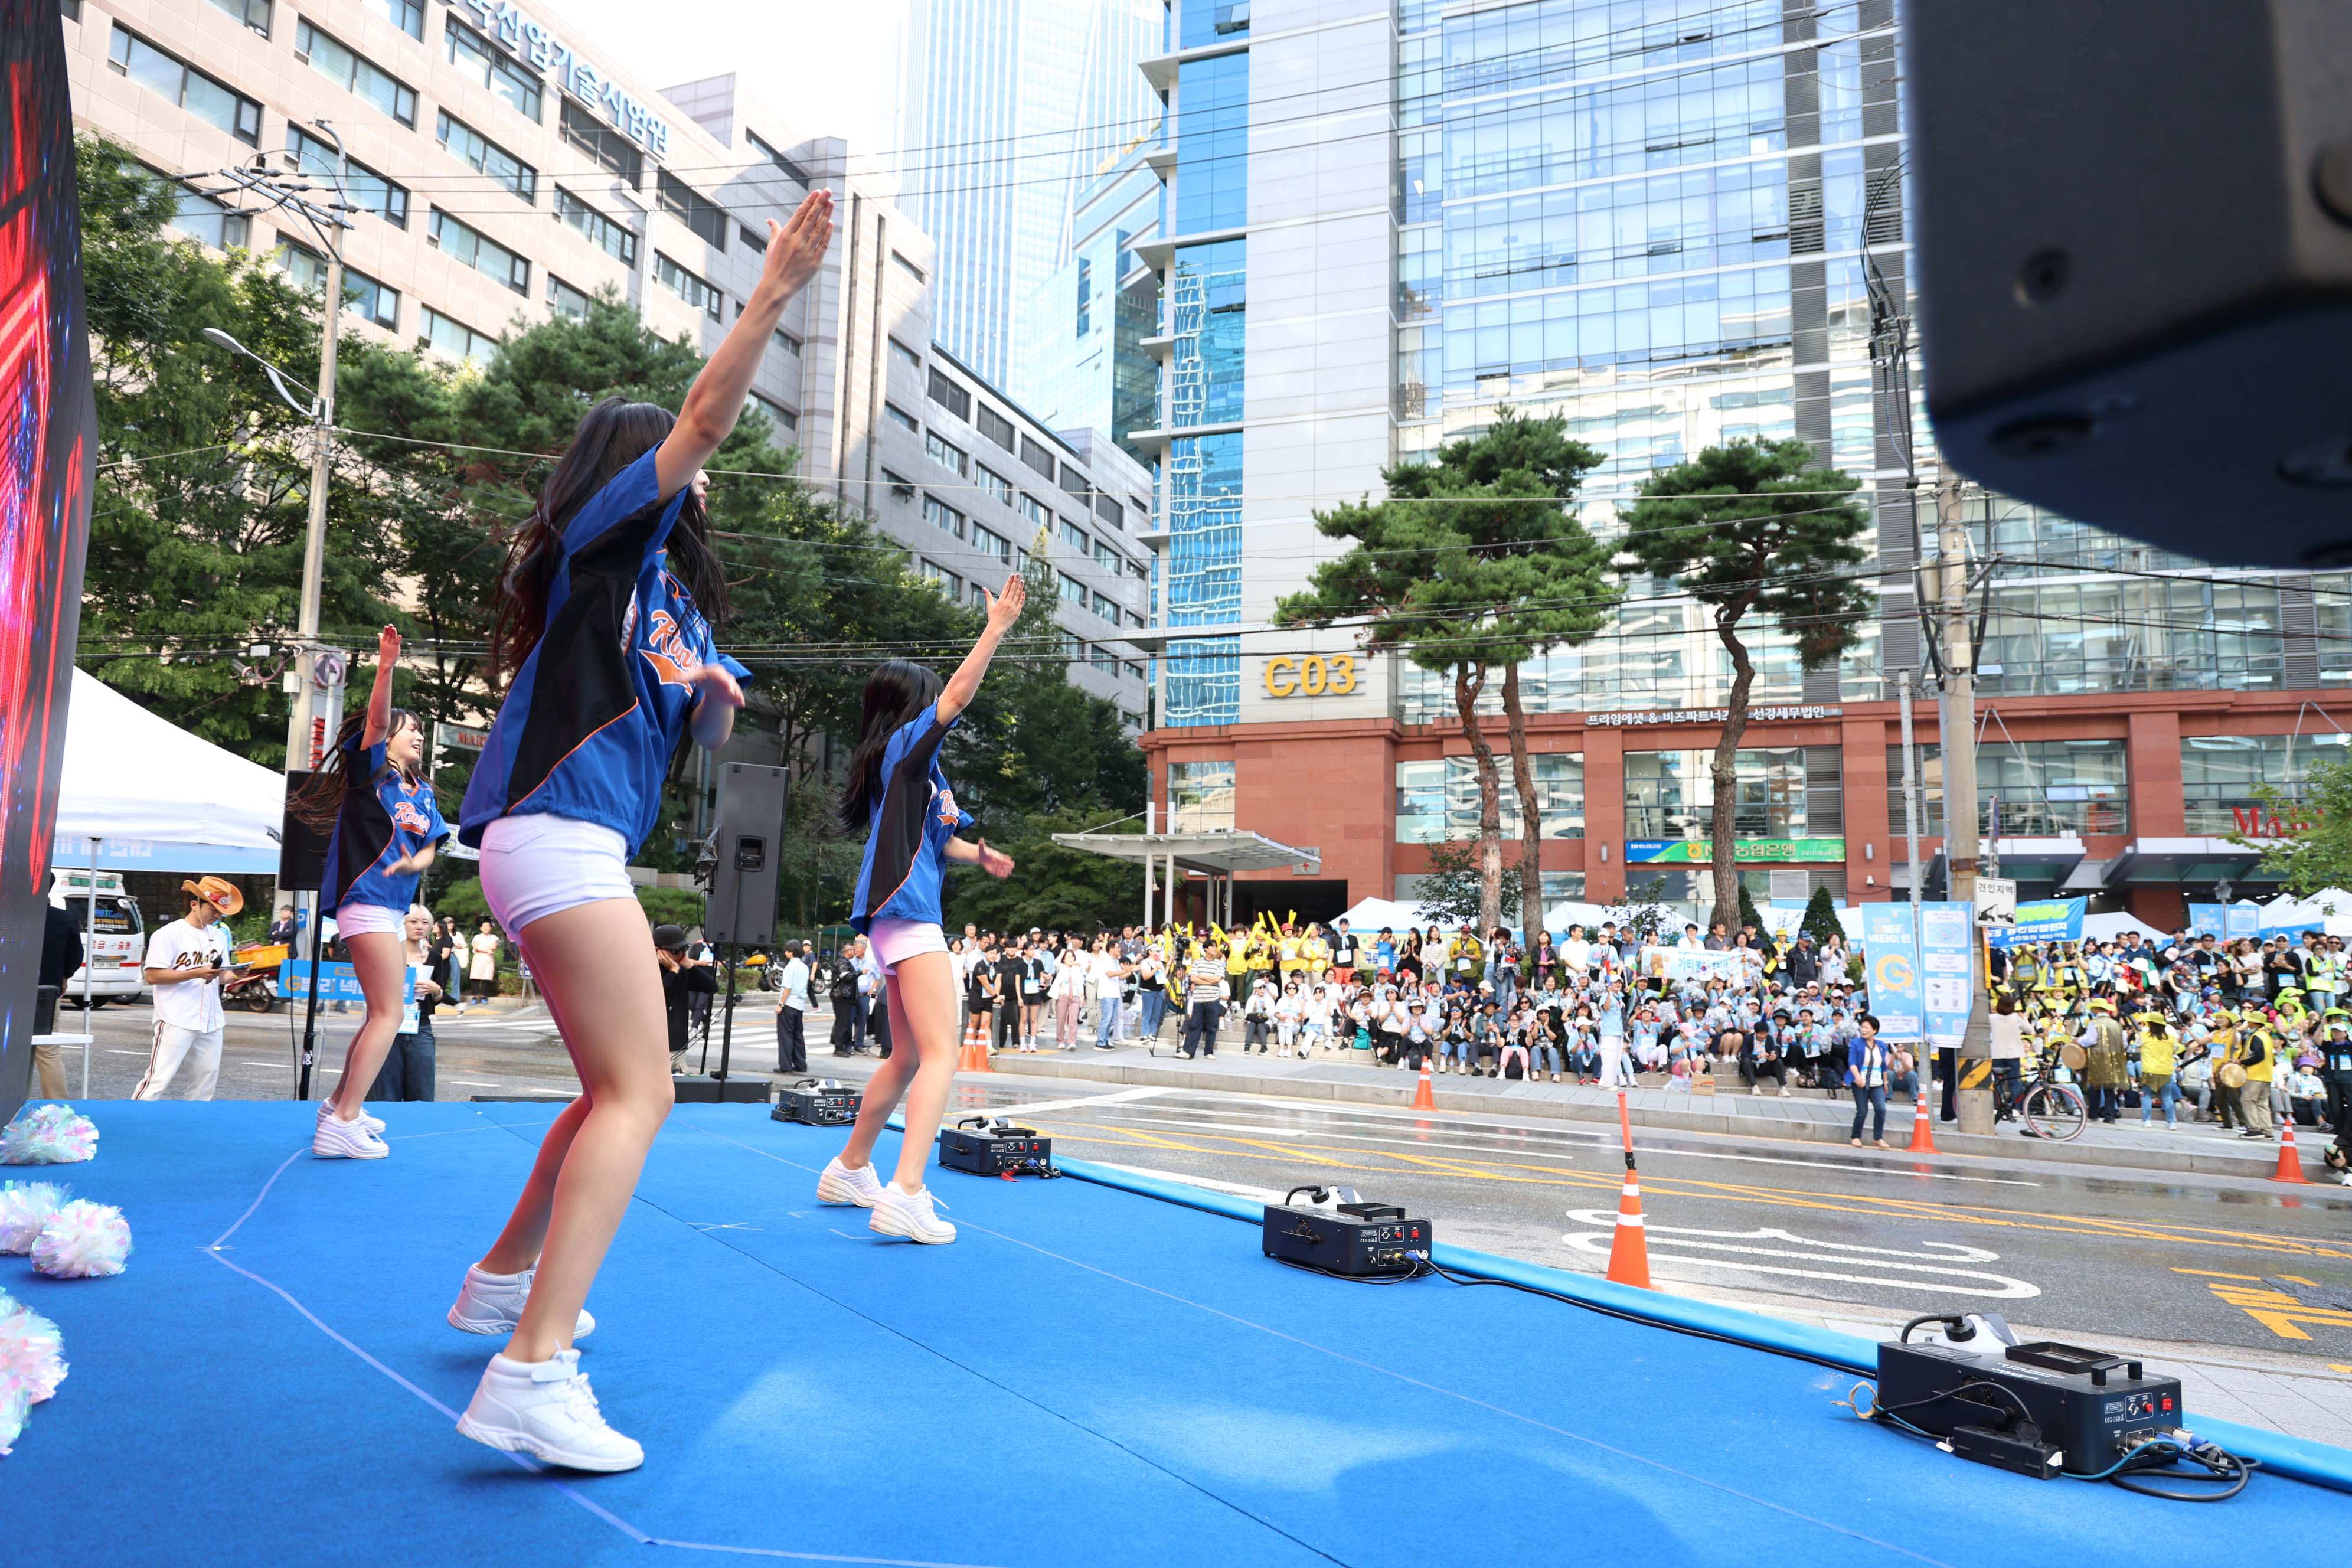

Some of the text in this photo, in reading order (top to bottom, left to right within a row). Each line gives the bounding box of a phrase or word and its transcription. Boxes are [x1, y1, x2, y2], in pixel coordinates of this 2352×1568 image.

[1265, 654, 1356, 697] C03
[1587, 714, 1644, 726] 프라임에셋
[1753, 706, 1824, 721] 선경세무법인
[1735, 843, 1796, 858] 농협은행
[1978, 882, 2014, 896] 견인지역
